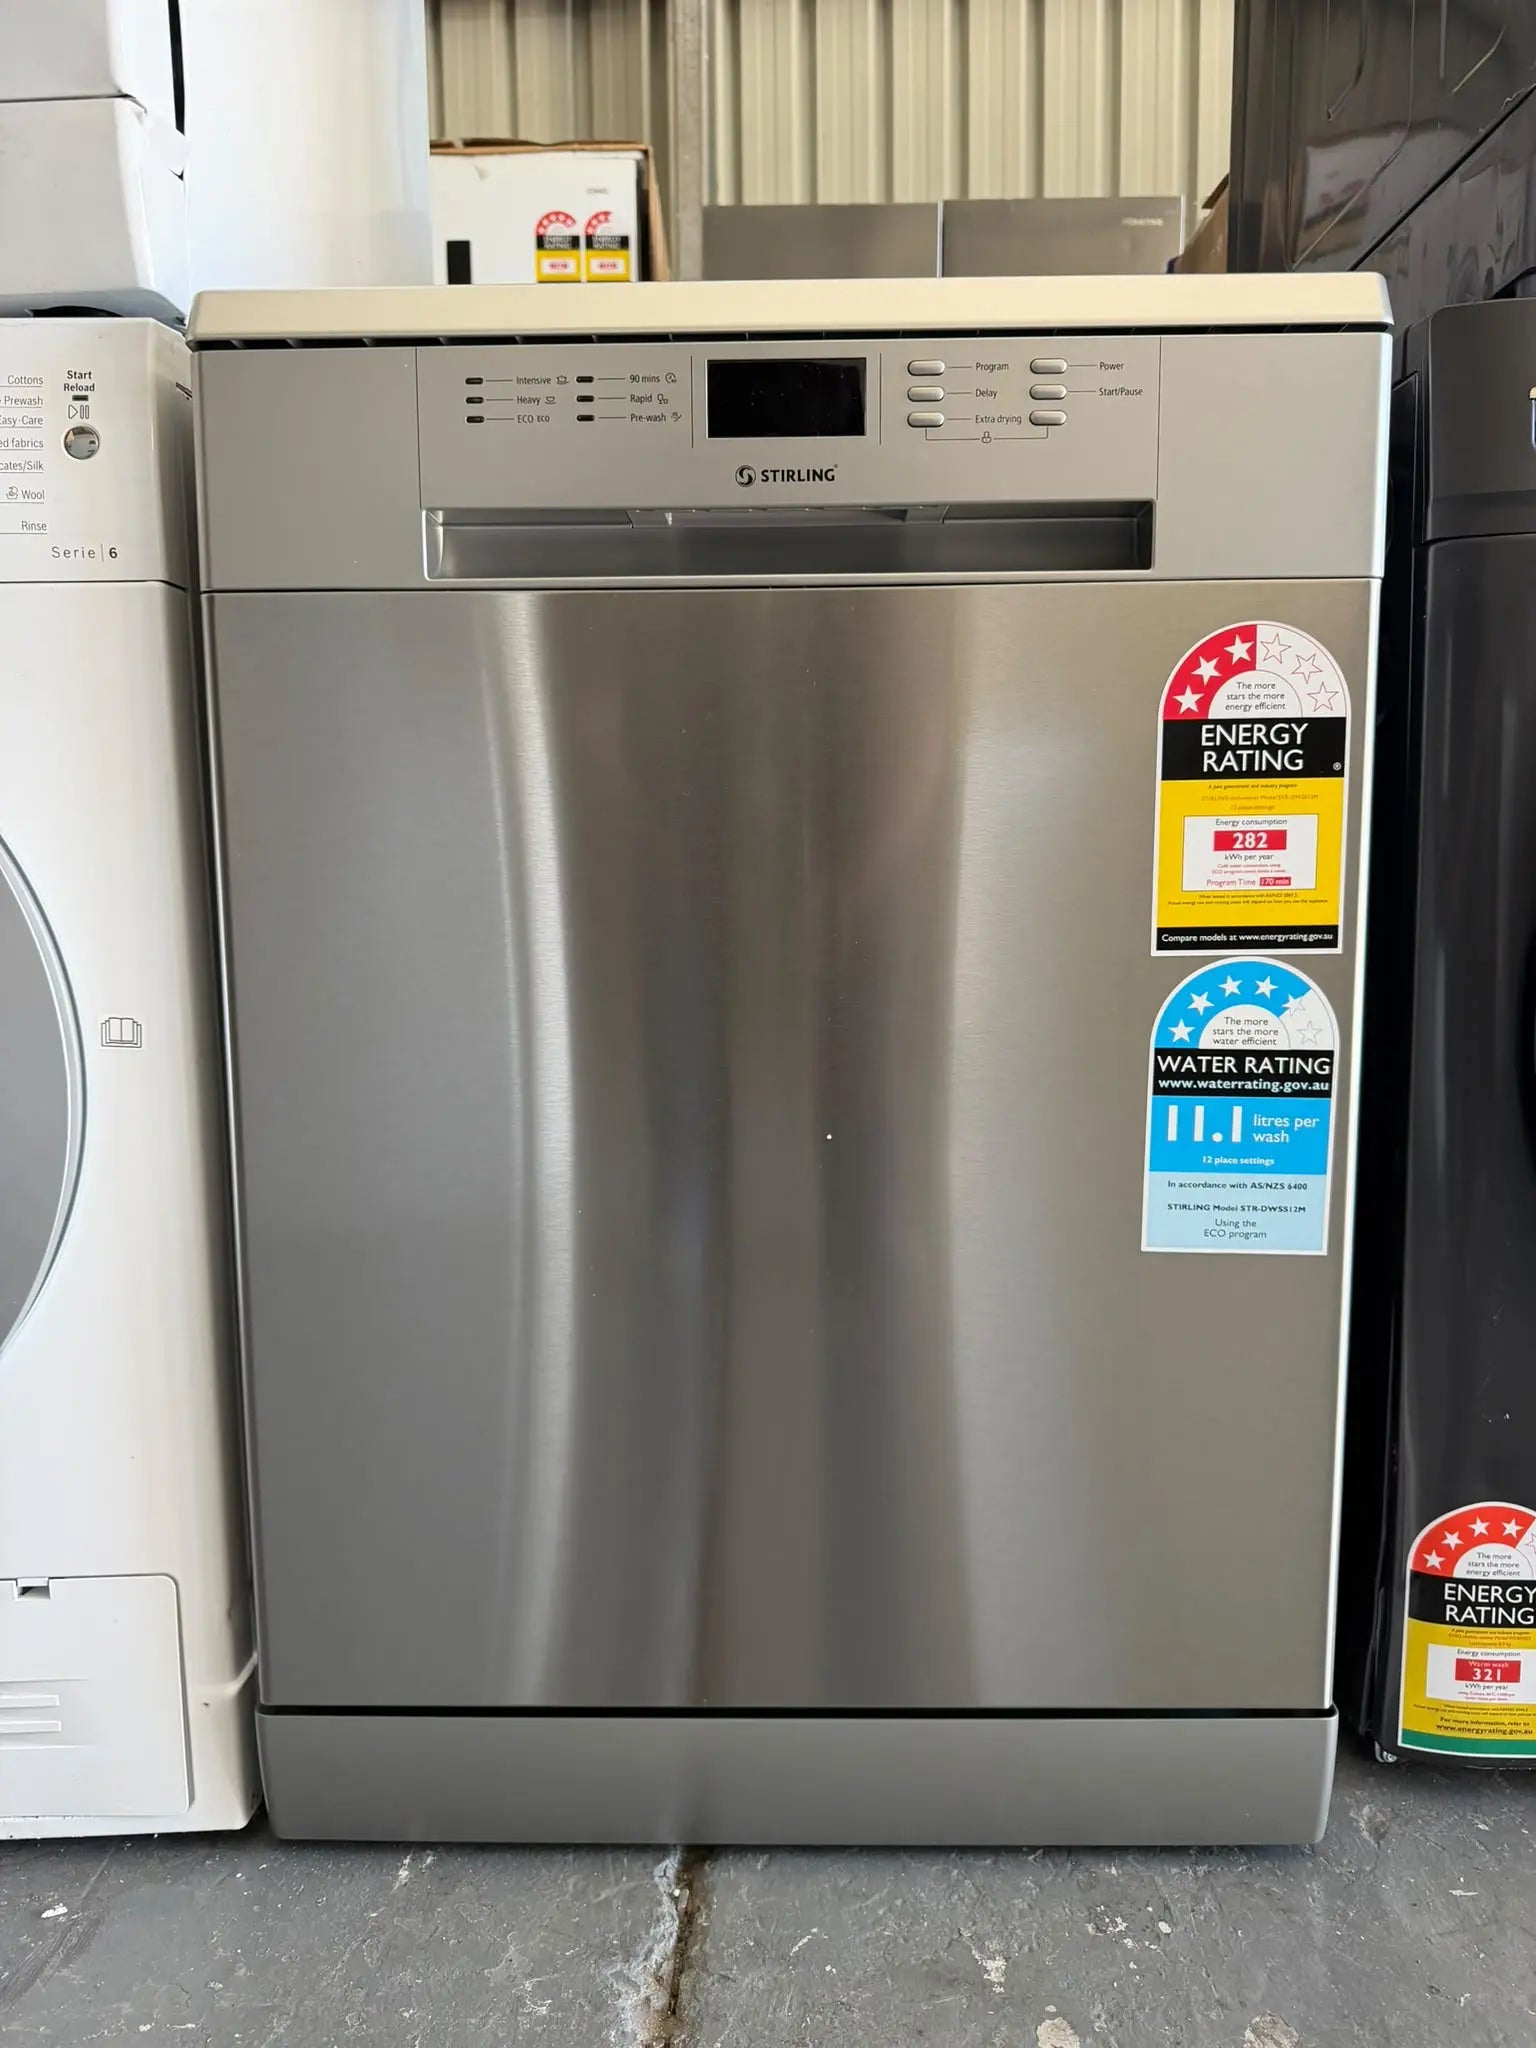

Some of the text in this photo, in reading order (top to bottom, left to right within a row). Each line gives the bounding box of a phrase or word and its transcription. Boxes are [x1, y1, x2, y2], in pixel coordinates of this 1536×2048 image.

[975, 361, 1009, 373] Program
[1099, 361, 1124, 371] Power
[7, 374, 44, 385] Cottons
[66, 370, 92, 380] Start
[516, 375, 552, 385] Intensive
[629, 374, 660, 384] 90 mins
[63, 383, 95, 392] Reload
[1099, 386, 1144, 397] Start/Pause
[630, 394, 653, 405] Rapid
[975, 388, 998, 400] Delay
[4, 396, 44, 406] Prewash
[516, 395, 541, 406] Heavy
[517, 414, 551, 424] ECO ECO
[630, 412, 667, 423] Pre-wash
[975, 413, 1022, 426] Extra drying
[11, 437, 44, 448] fabrics
[760, 467, 836, 483] STIRLING
[21, 489, 45, 500] Wool
[21, 520, 48, 532] Rinse
[51, 546, 119, 560] Serie 6
[1236, 681, 1253, 690] The
[1226, 692, 1285, 701] stars the more
[1225, 702, 1287, 712] energy efficient
[1200, 722, 1309, 747] ENERGY
[1202, 748, 1305, 773] RATING
[1215, 818, 1288, 827] Energy consumption
[1232, 831, 1269, 849] 282
[1224, 853, 1274, 863] kWh per year
[1206, 877, 1290, 888] Program Time 170 min
[1161, 932, 1334, 943] Compare models at www.energyrating.gov.au
[1223, 1016, 1269, 1026] The more
[1212, 1028, 1234, 1036] stars
[1236, 1027, 1252, 1036] the
[1241, 1037, 1277, 1047] efficient
[1156, 1055, 1331, 1075] WATER RATING
[1158, 1078, 1330, 1093] www.waterrating.gov.au
[1166, 1104, 1244, 1144] 11.1
[1252, 1113, 1321, 1132] litres per
[1252, 1130, 1290, 1143] wash
[1201, 1155, 1276, 1167] 12 place settings
[1167, 1180, 1308, 1191] In accordance with AS/NZS 6400
[1167, 1203, 1211, 1212] STIRLING
[1212, 1204, 1239, 1213] Model
[1214, 1218, 1257, 1229] Using the
[1203, 1228, 1268, 1241] ECO program
[1476, 1551, 1491, 1560] The
[1466, 1569, 1521, 1577] energy efficient
[1443, 1582, 1536, 1605] ENERGY
[1444, 1604, 1535, 1626] RATING
[1456, 1648, 1522, 1658] Energy consumption
[1468, 1660, 1491, 1668] Warm
[1472, 1668, 1502, 1681] 321
[1464, 1682, 1482, 1690] kWh
[1435, 1723, 1534, 1736] www.energyrating.gov.au
